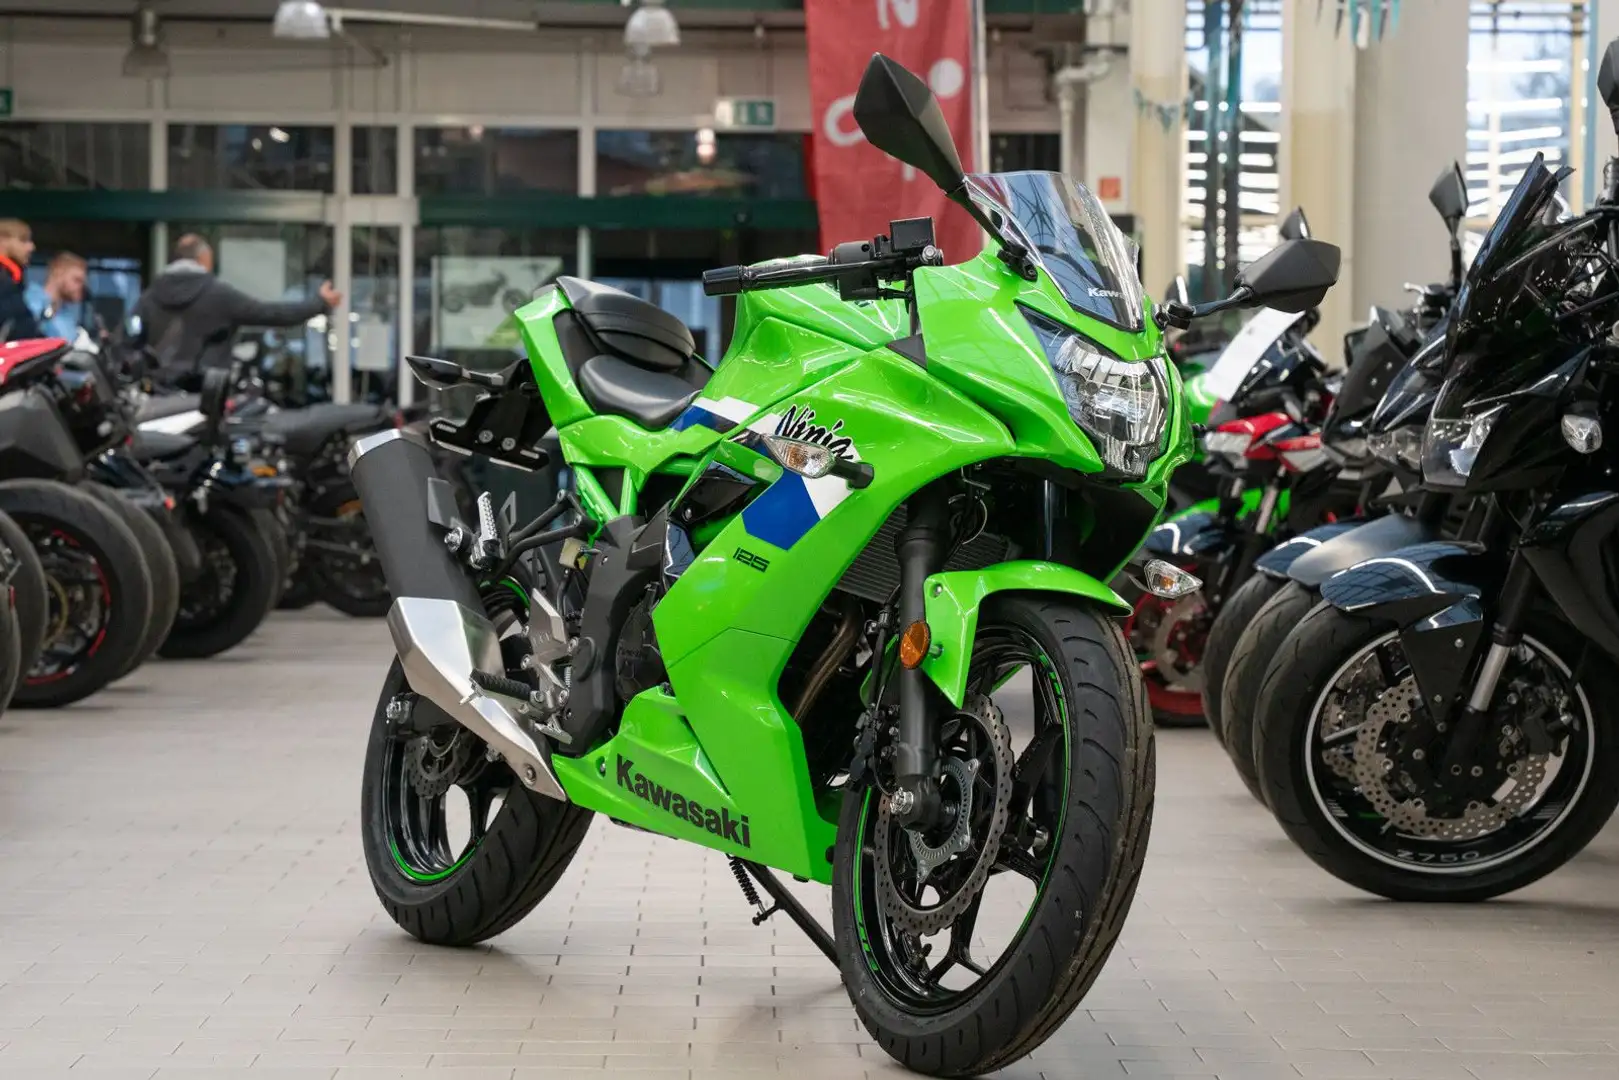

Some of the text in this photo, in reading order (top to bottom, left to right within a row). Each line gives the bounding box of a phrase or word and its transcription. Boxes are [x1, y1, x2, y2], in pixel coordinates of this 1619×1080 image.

[774, 404, 855, 460] Ninja
[733, 546, 771, 573] 125
[616, 752, 751, 849] Kawasaki
[1396, 848, 1481, 863] Z750
